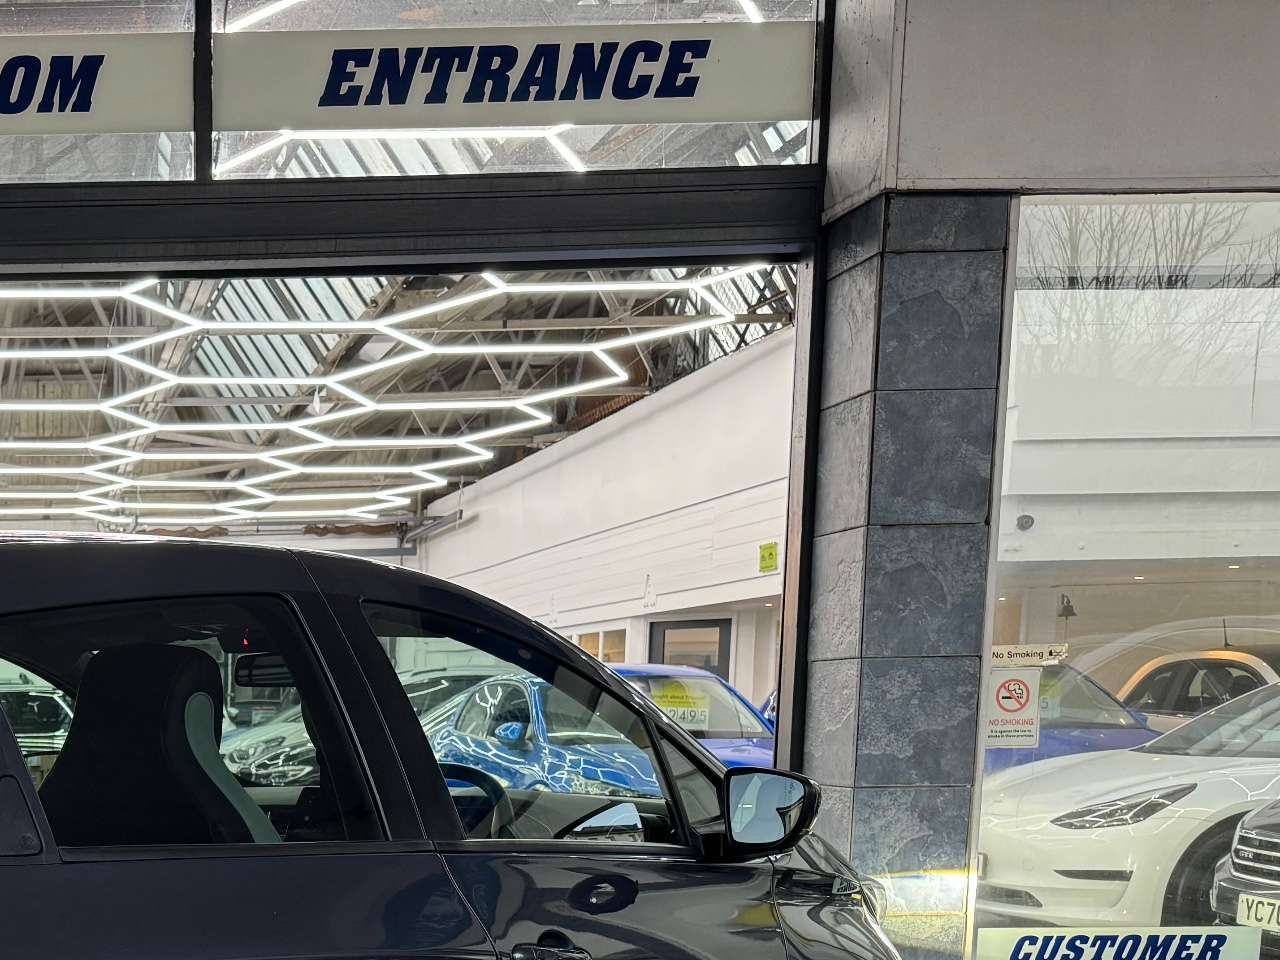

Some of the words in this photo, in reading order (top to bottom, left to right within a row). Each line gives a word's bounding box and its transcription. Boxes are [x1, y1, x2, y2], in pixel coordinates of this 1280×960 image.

[317, 39, 712, 107] ENTRANCE
[992, 651, 1005, 660] No
[1007, 650, 1044, 661] Smoking
[668, 708, 707, 722] 2495
